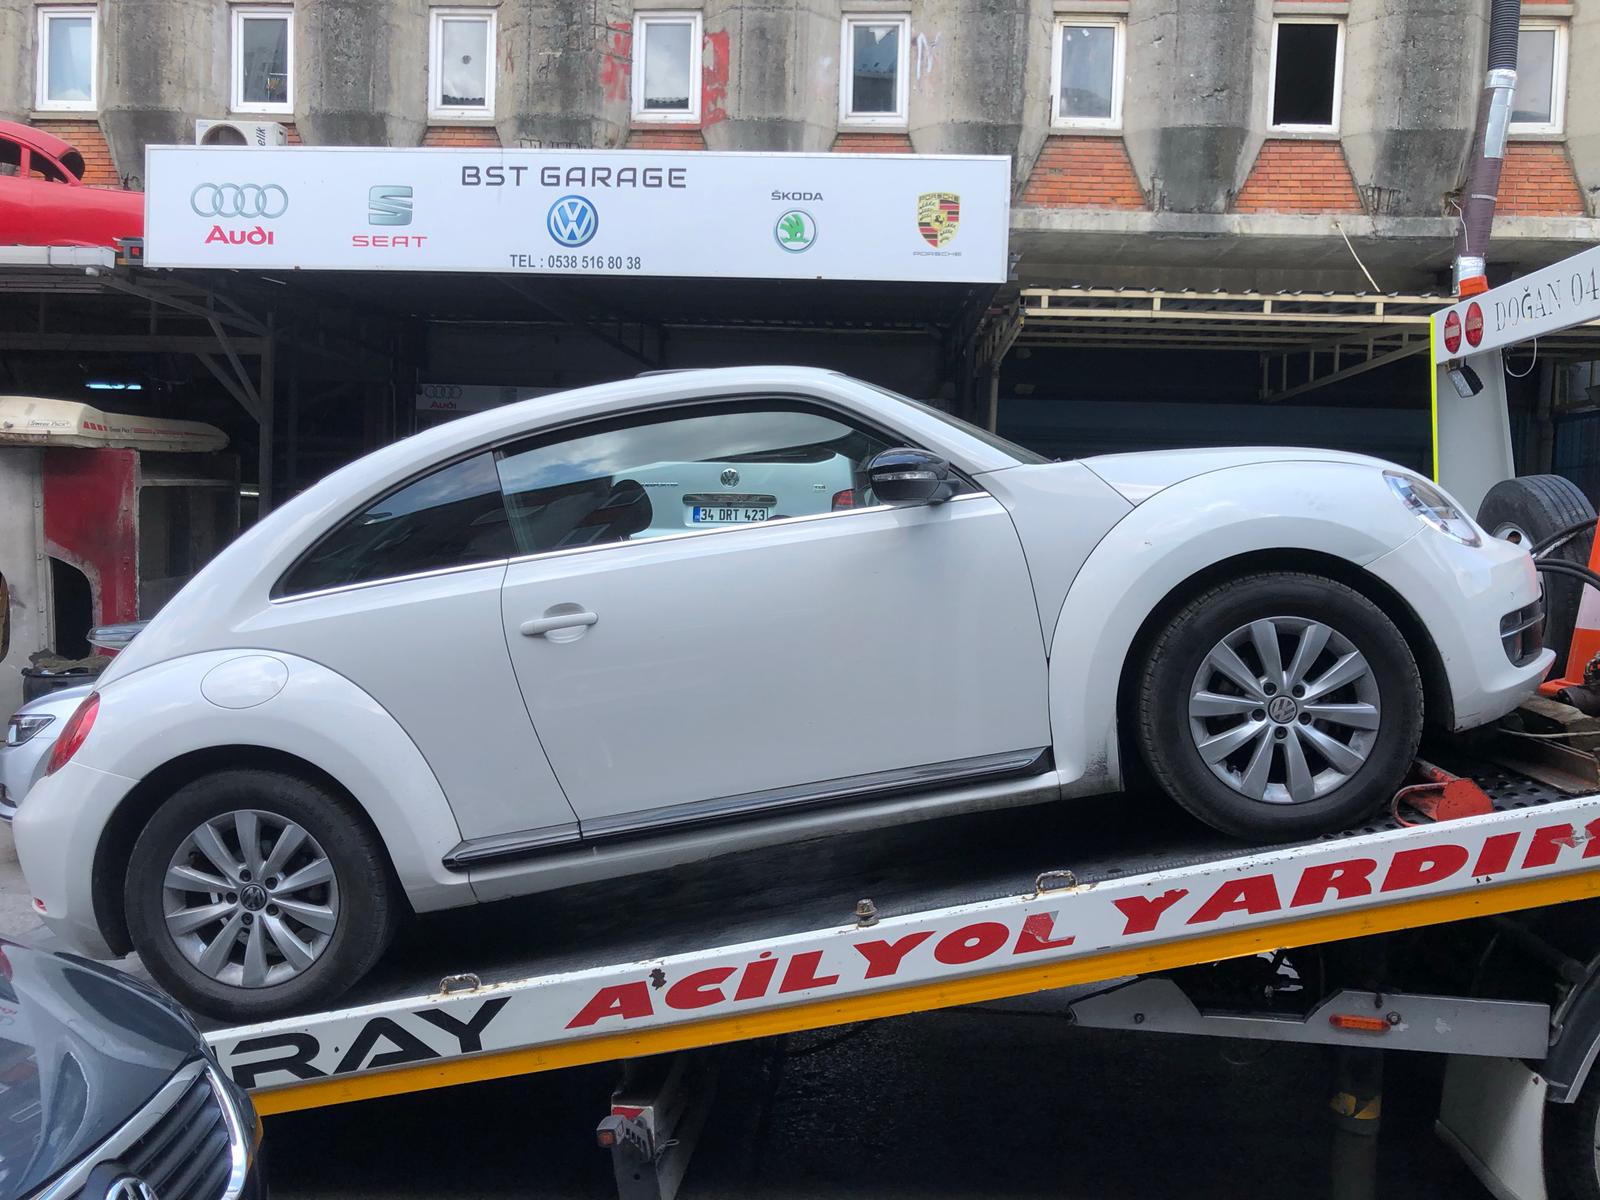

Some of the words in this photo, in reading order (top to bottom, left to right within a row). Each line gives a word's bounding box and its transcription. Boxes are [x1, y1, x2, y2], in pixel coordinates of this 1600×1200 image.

[461, 165, 528, 187] BST
[540, 166, 687, 189] GARAGE
[771, 190, 824, 201] ŠKODA
[204, 224, 275, 246] Audi
[352, 235, 428, 248] SEAT
[547, 255, 578, 269] 0538
[581, 255, 604, 269] 516
[607, 256, 623, 269] 80
[626, 256, 642, 270] 38
[1495, 279, 1562, 332] DOĞAN
[700, 508, 714, 521] 34
[719, 508, 740, 521] DRT
[744, 509, 766, 522] 423
[211, 997, 512, 1089] RAY
[853, 910, 1076, 978] YOL
